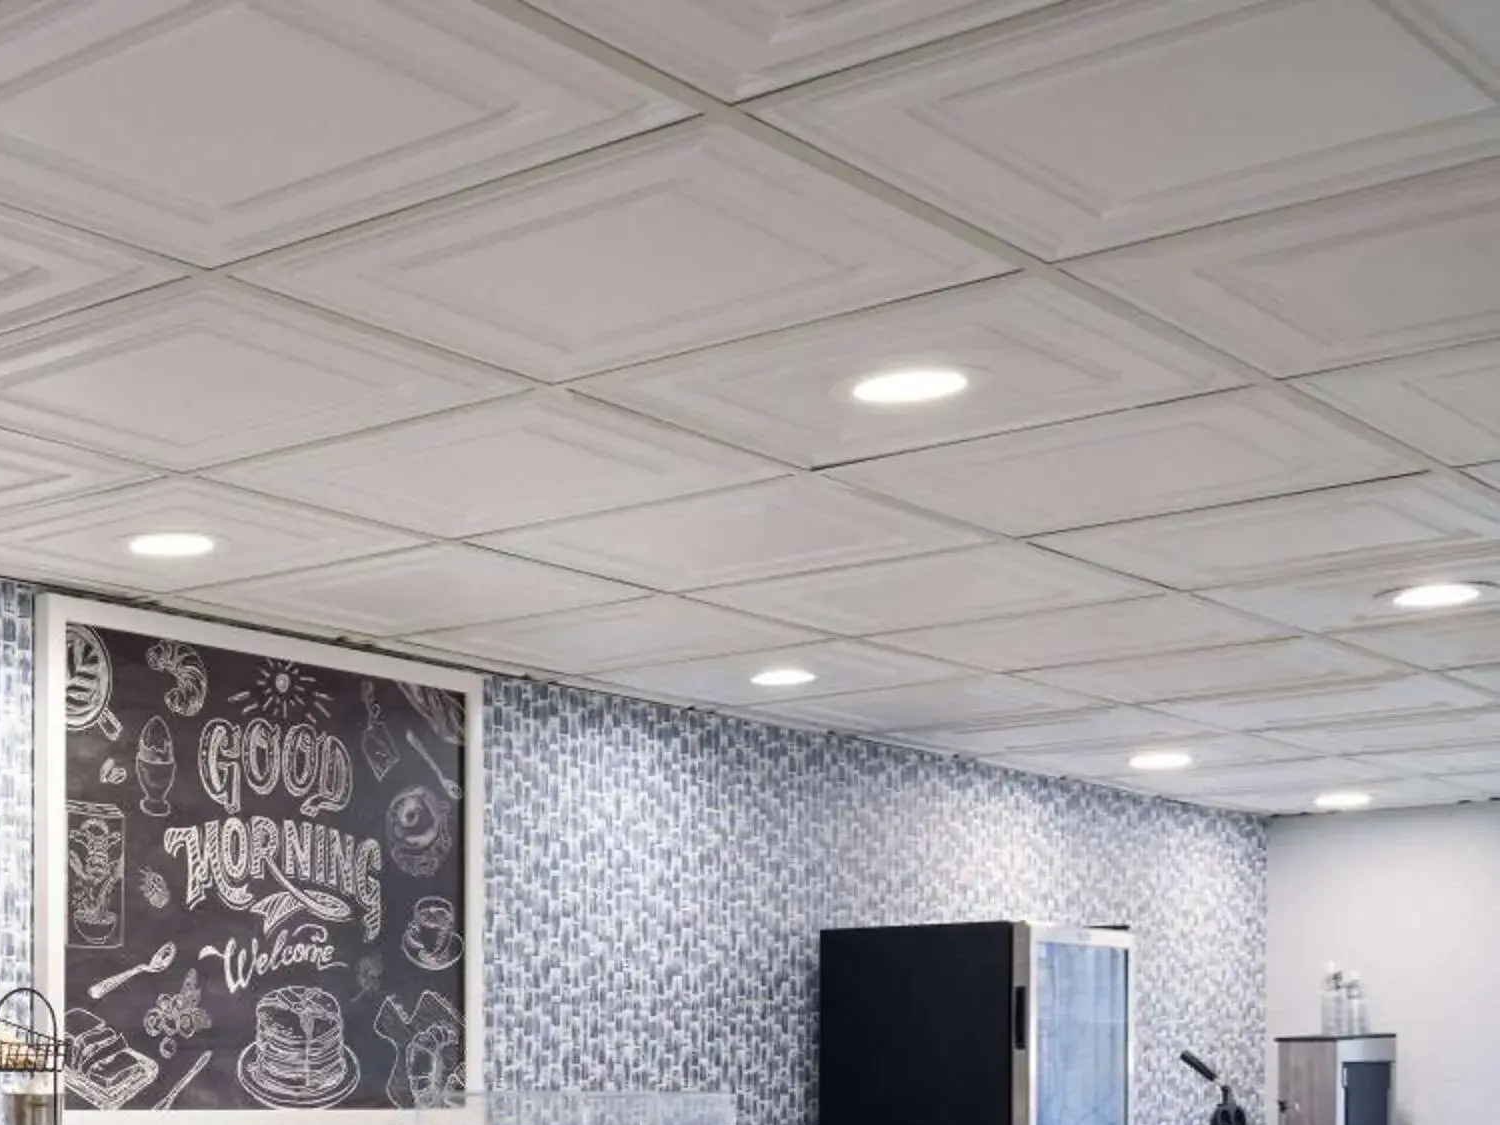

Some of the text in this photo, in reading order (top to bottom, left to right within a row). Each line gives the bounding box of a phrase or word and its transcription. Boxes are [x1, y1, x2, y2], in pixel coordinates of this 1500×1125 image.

[198, 717, 353, 816] GOOD
[164, 815, 382, 942] MORNING
[198, 923, 348, 993] Welcome
